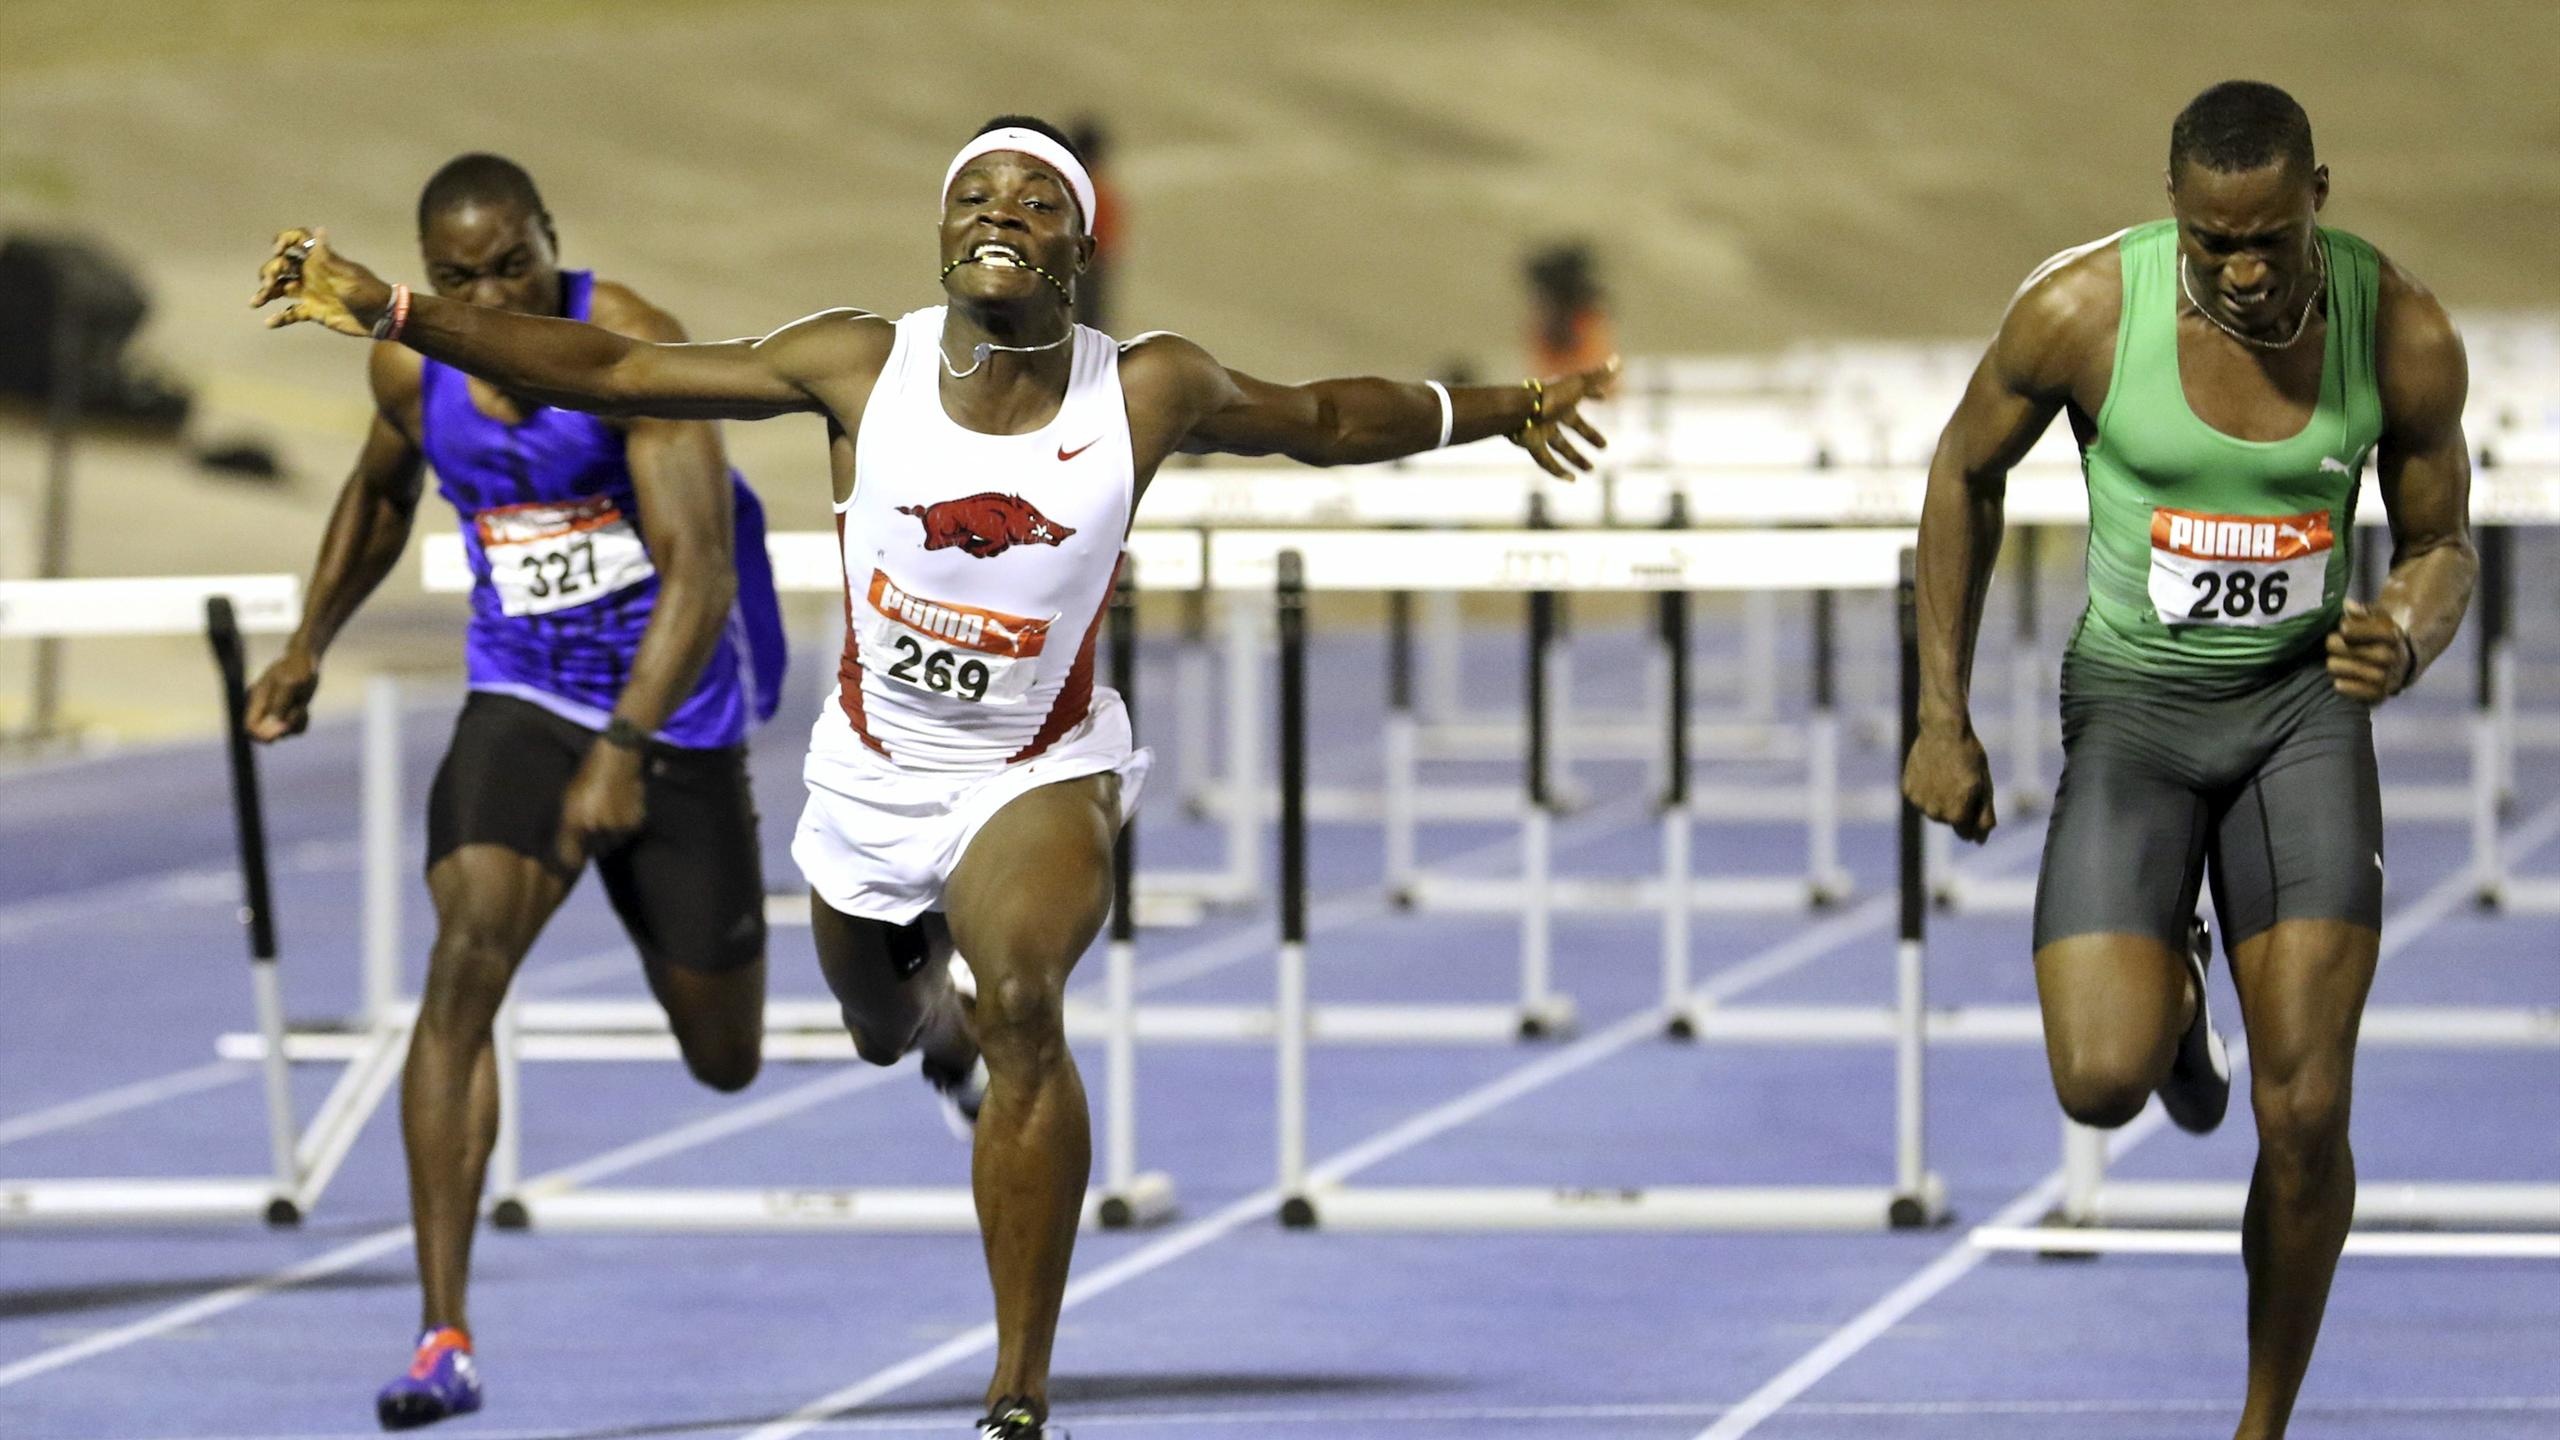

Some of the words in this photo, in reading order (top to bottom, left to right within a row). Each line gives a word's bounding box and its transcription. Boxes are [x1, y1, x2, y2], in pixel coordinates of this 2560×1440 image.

[2169, 515, 2276, 558] PUMA
[522, 540, 597, 597] 327
[2188, 570, 2290, 619] 286
[880, 582, 985, 646] PUMA
[888, 635, 990, 702] 269
